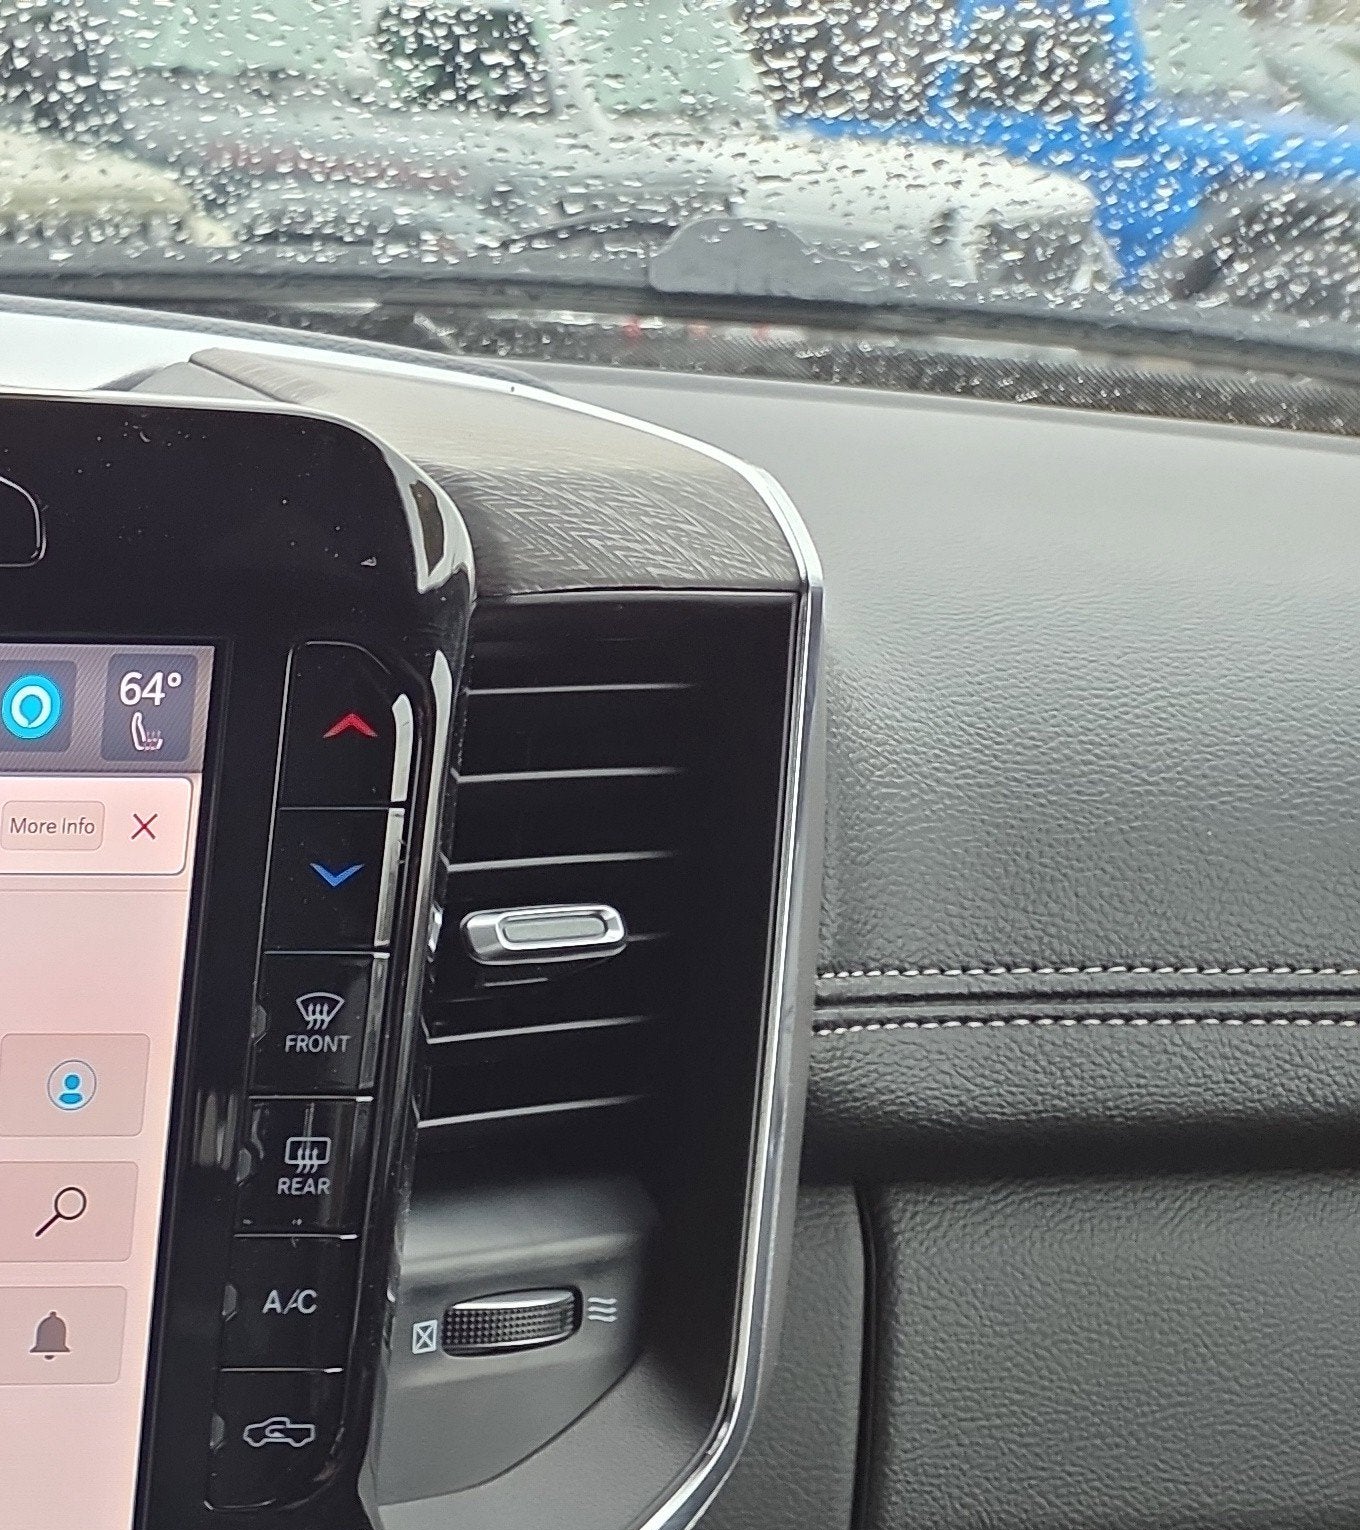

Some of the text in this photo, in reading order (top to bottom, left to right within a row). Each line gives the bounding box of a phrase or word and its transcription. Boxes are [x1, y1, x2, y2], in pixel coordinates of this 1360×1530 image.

[118, 671, 183, 707] 64°
[9, 816, 96, 837] More Info
[284, 1034, 351, 1053] FRONT
[277, 1176, 331, 1196] REAR
[261, 1288, 319, 1315] A/C
